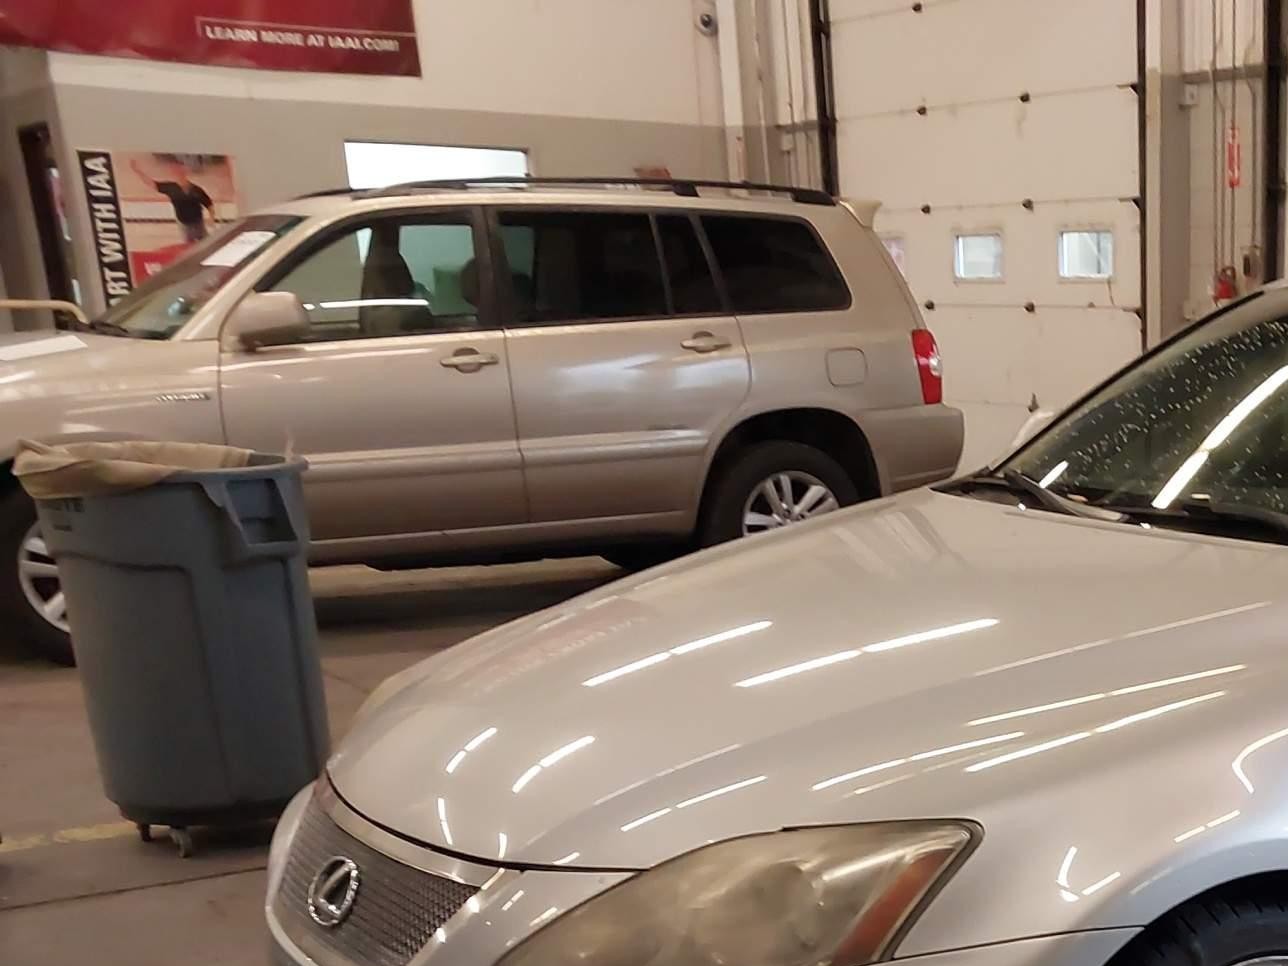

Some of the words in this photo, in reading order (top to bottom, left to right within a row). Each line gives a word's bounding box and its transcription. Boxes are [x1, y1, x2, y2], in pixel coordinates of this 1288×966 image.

[206, 25, 258, 42] LEARN
[260, 31, 304, 47] MORE
[307, 34, 325, 48] AT
[84, 157, 113, 197] IAA
[93, 203, 123, 263] WITH
